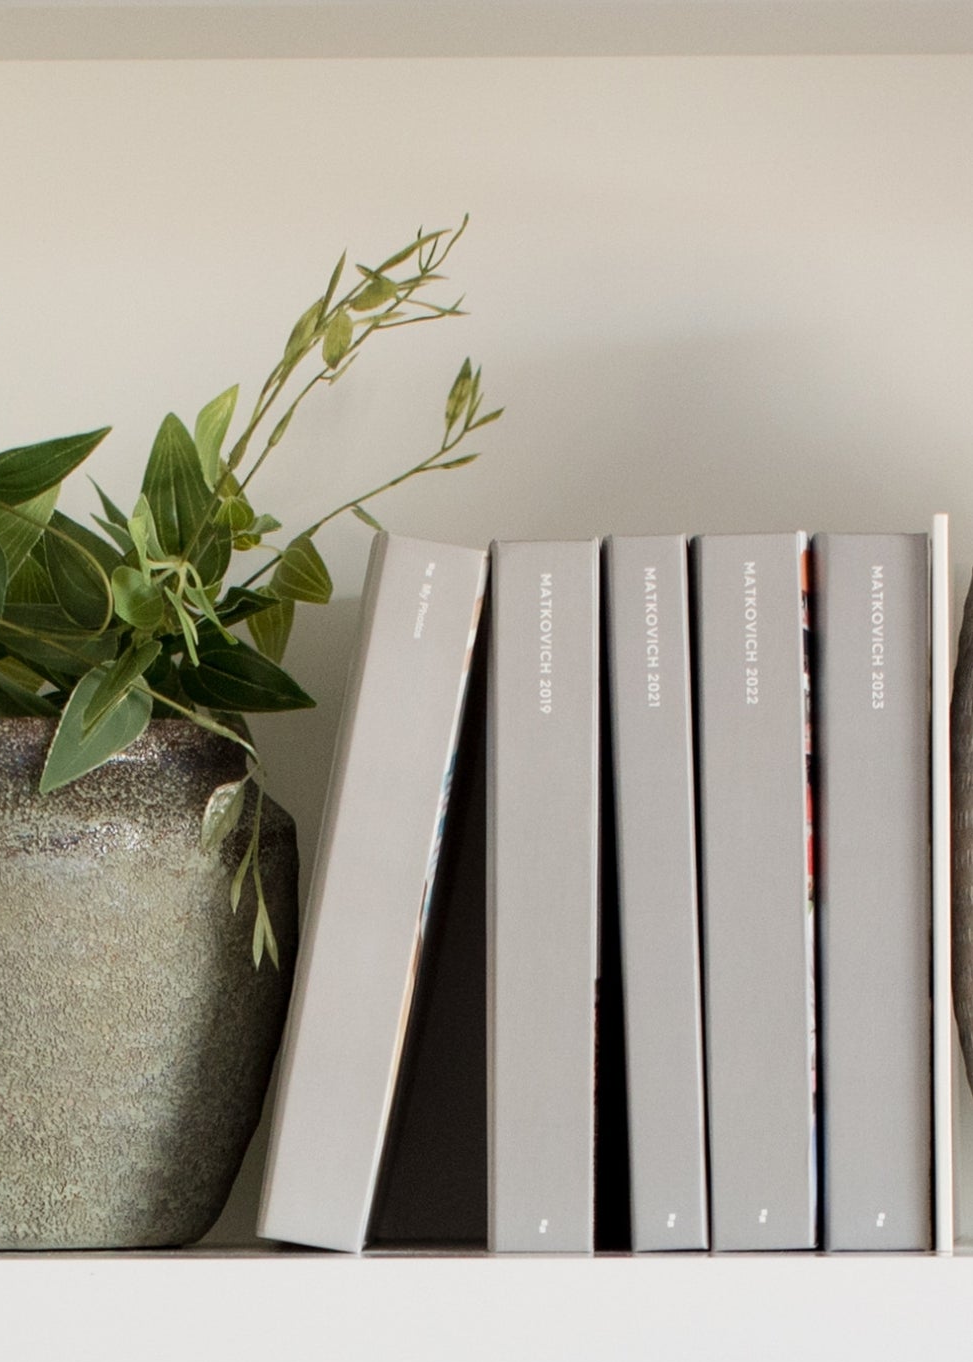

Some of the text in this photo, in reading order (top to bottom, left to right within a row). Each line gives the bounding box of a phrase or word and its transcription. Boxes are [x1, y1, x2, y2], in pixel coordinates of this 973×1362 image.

[539, 573, 553, 714] MATKOVICH 2019
[643, 567, 661, 707] MATKOVICH 2021
[744, 561, 759, 705] MATKOVICH 2022
[871, 565, 885, 710] MATKOVICH 2023
